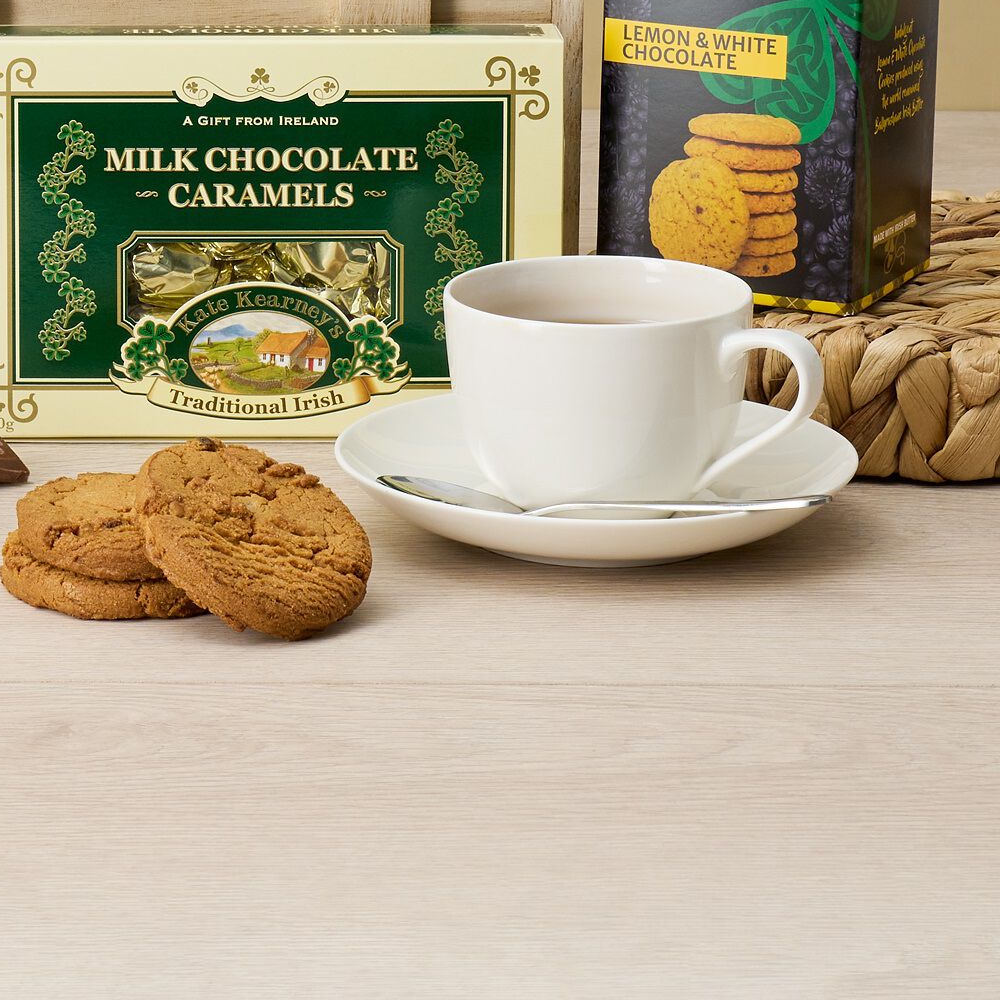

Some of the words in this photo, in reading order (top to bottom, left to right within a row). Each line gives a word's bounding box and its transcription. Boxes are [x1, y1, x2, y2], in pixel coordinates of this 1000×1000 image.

[623, 24, 691, 47] LEMON
[695, 32, 709, 49] &
[712, 33, 777, 56] WHITE
[622, 43, 737, 70] CHOCOLATE
[182, 115, 193, 126] A
[235, 116, 273, 126] FROM
[104, 147, 199, 172] MILK
[204, 146, 419, 173] CHOCOLATE
[167, 182, 355, 208] CARAMELS
[175, 299, 230, 336] Kate
[234, 289, 345, 340] Kearney's
[169, 387, 288, 415] Traditional
[293, 390, 345, 413] Irish
